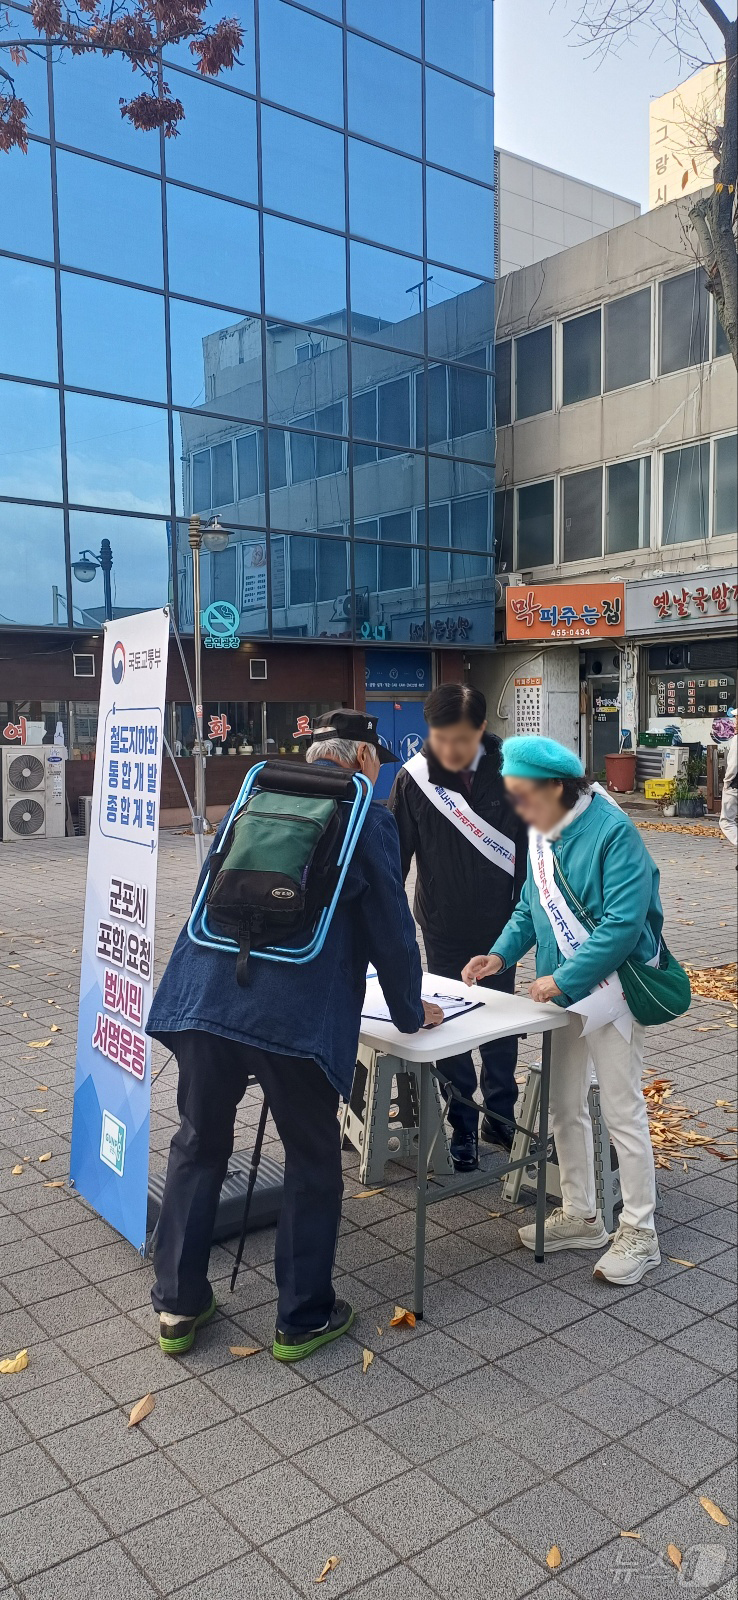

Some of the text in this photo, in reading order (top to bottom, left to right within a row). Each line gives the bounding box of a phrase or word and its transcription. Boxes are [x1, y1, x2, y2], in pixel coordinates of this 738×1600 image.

[510, 591, 621, 627] 막퍼주는집
[204, 637, 240, 649] 금연광장
[550, 628, 591, 637] 455-0434
[128, 647, 162, 671] 국토교통부
[110, 725, 159, 756] 철도지하화
[453, 808, 485, 838] 내려가면
[109, 878, 148, 927] 군포시
[97, 921, 151, 979] 포함 요청
[104, 969, 144, 1026] 범시민
[93, 1013, 146, 1080] 서명운동
